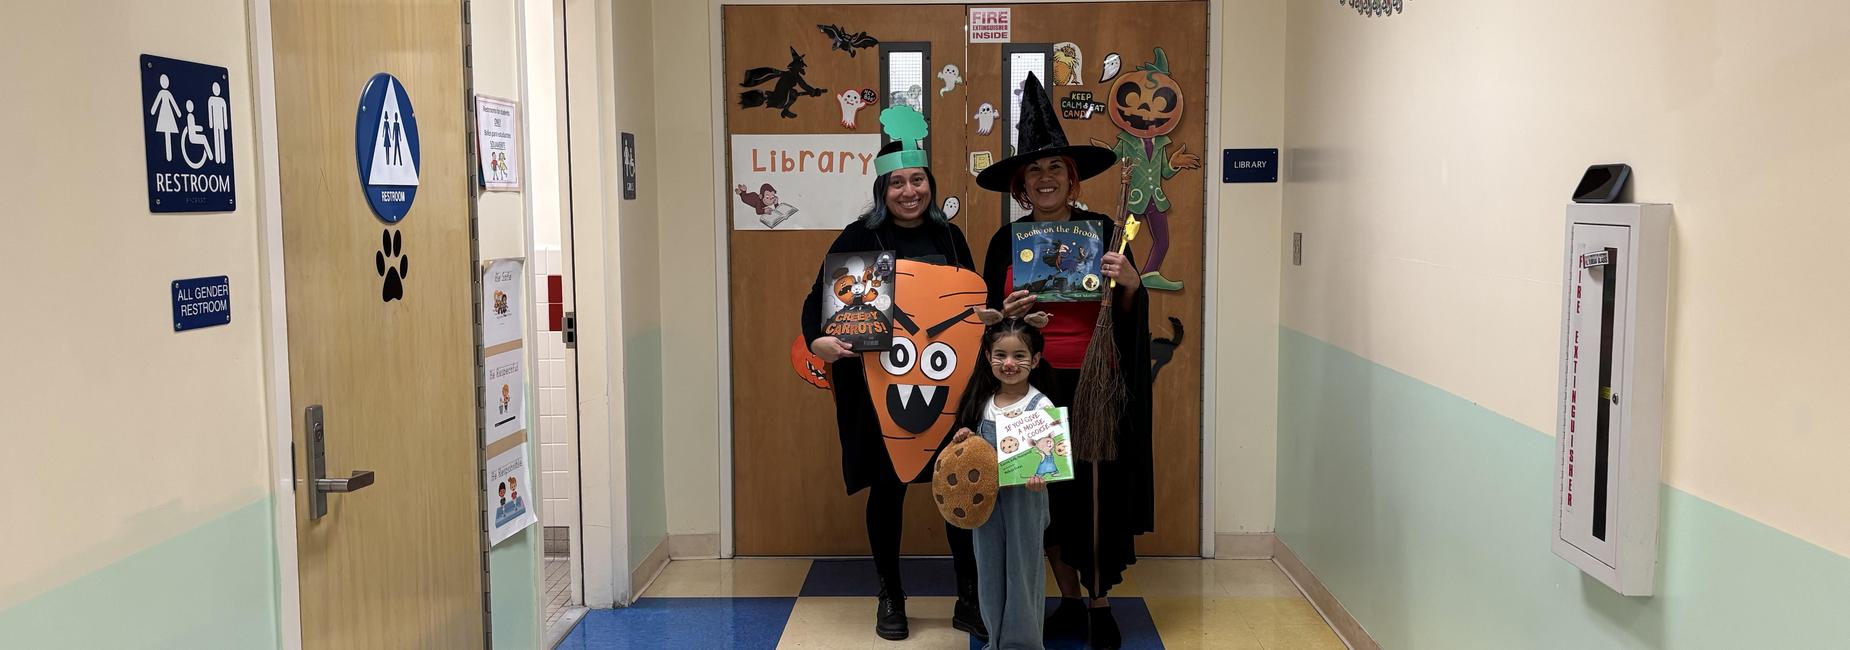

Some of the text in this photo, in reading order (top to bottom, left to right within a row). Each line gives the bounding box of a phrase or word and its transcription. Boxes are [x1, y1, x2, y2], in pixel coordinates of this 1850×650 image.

[972, 11, 1008, 24] FIRE
[1071, 92, 1092, 101] KEEP
[1062, 100, 1082, 109] CALM
[752, 148, 873, 175] Library
[1234, 160, 1267, 169] LIBRARY
[156, 173, 230, 193] RESTROOM
[381, 191, 405, 202] RESTROOM
[1016, 228, 1041, 240] Room
[1072, 225, 1100, 240] Broom
[177, 284, 229, 301] ALL GENDER
[181, 299, 228, 317] RESTROOM
[835, 311, 878, 322] CREEPY
[825, 321, 888, 336] CARROTS!
[1004, 412, 1040, 433] IF YOU GIVE
[1023, 418, 1045, 431] MOUSE
[1567, 330, 1579, 507] EXTINGUISHER
[1027, 423, 1050, 439] COOKIE
